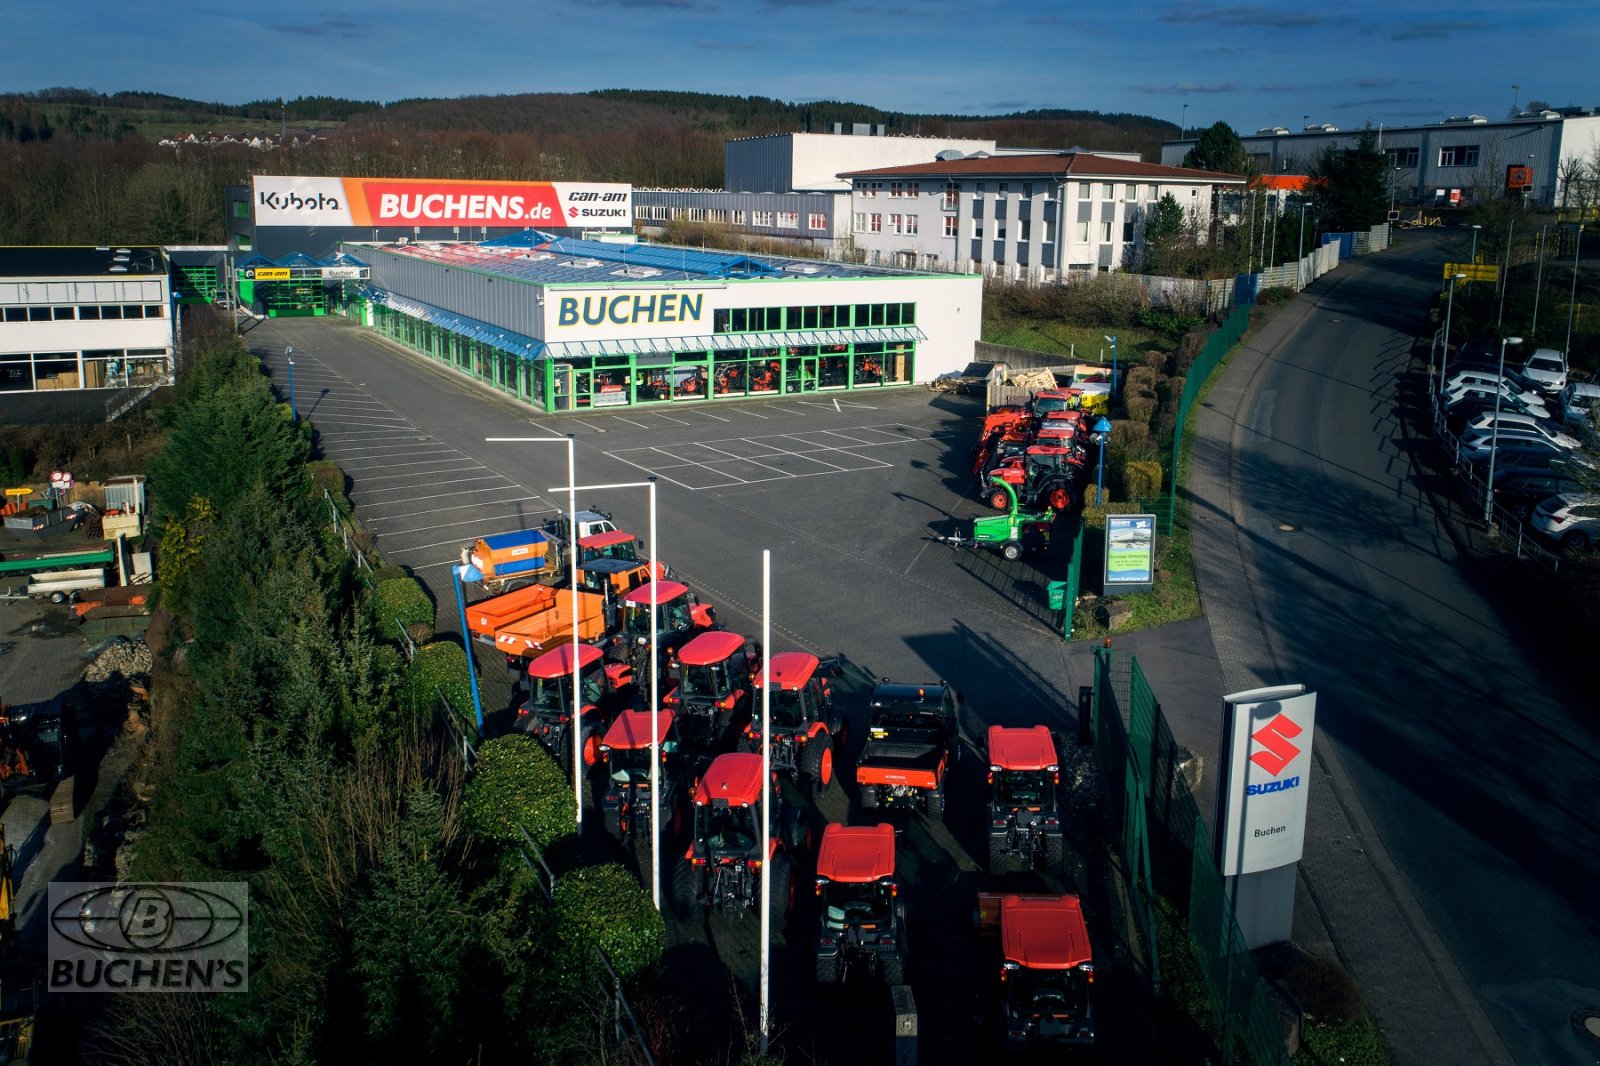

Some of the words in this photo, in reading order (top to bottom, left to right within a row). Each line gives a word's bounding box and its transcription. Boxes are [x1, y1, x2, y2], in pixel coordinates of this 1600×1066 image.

[260, 191, 339, 211] Kubota
[568, 191, 627, 202] can-am
[379, 193, 552, 221] BUCHENS.de
[581, 208, 626, 217] SUZUKI
[557, 292, 704, 327] BUCHEN
[1246, 776, 1300, 796] SUZUKI
[1254, 825, 1286, 838] Buchen
